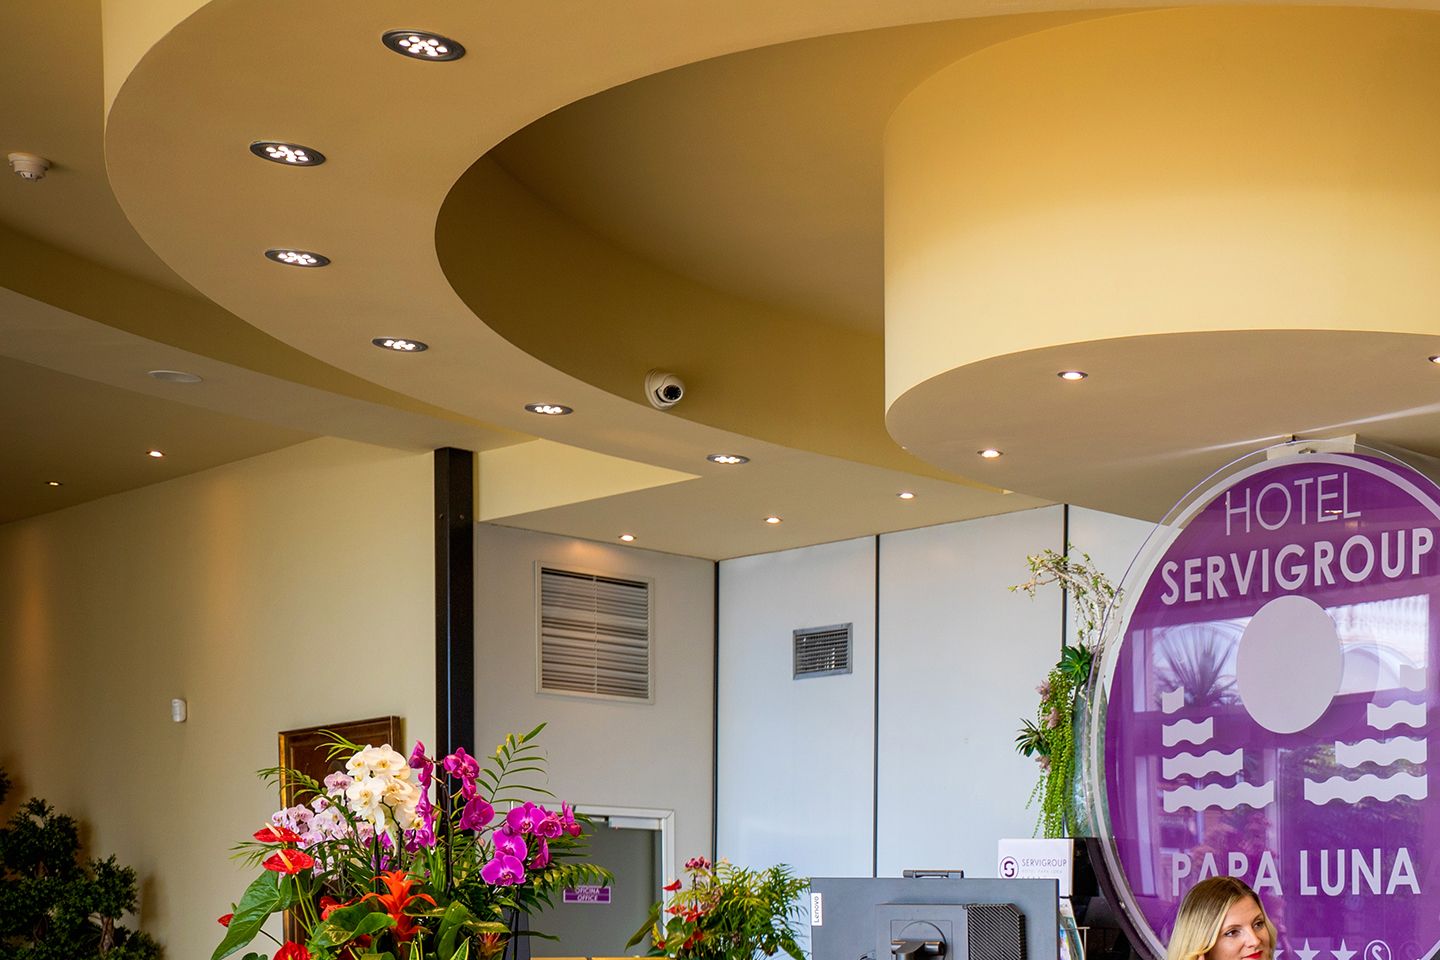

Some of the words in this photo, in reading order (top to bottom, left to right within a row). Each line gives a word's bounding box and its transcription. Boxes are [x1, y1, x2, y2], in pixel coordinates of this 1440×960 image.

[1225, 472, 1362, 536] HOTEL
[1160, 527, 1434, 606] SERVIGROUP
[1021, 858, 1067, 867] SERVIGROUP
[1300, 847, 1422, 897] LUNA
